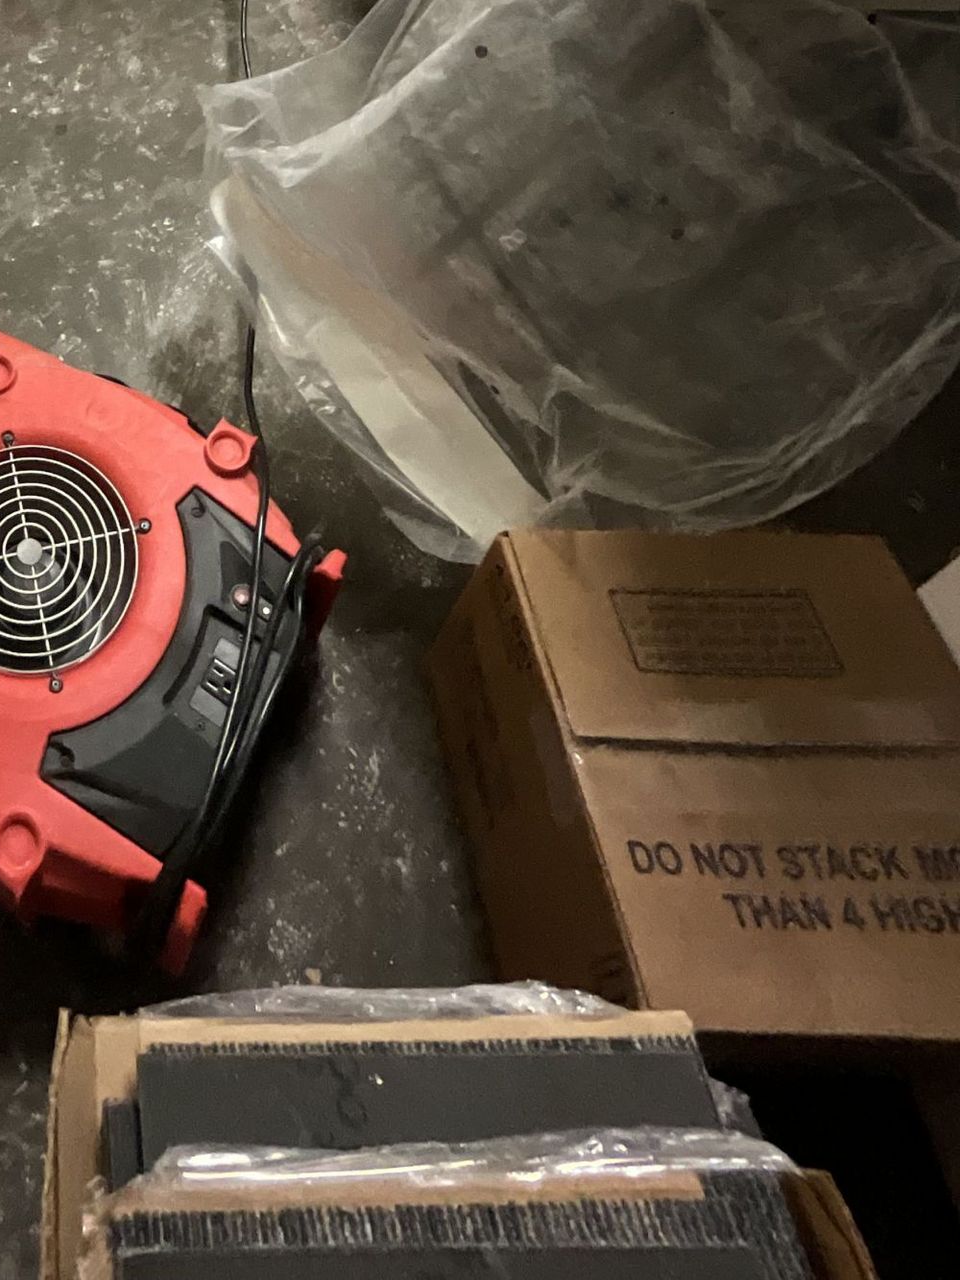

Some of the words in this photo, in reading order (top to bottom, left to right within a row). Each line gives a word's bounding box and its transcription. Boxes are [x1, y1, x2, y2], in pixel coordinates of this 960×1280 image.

[626, 839, 683, 875] DO
[690, 842, 766, 880] NOT
[776, 844, 910, 882] STACK
[723, 891, 832, 931] THAN
[843, 896, 866, 931] 4
[870, 894, 960, 933] HIGH
